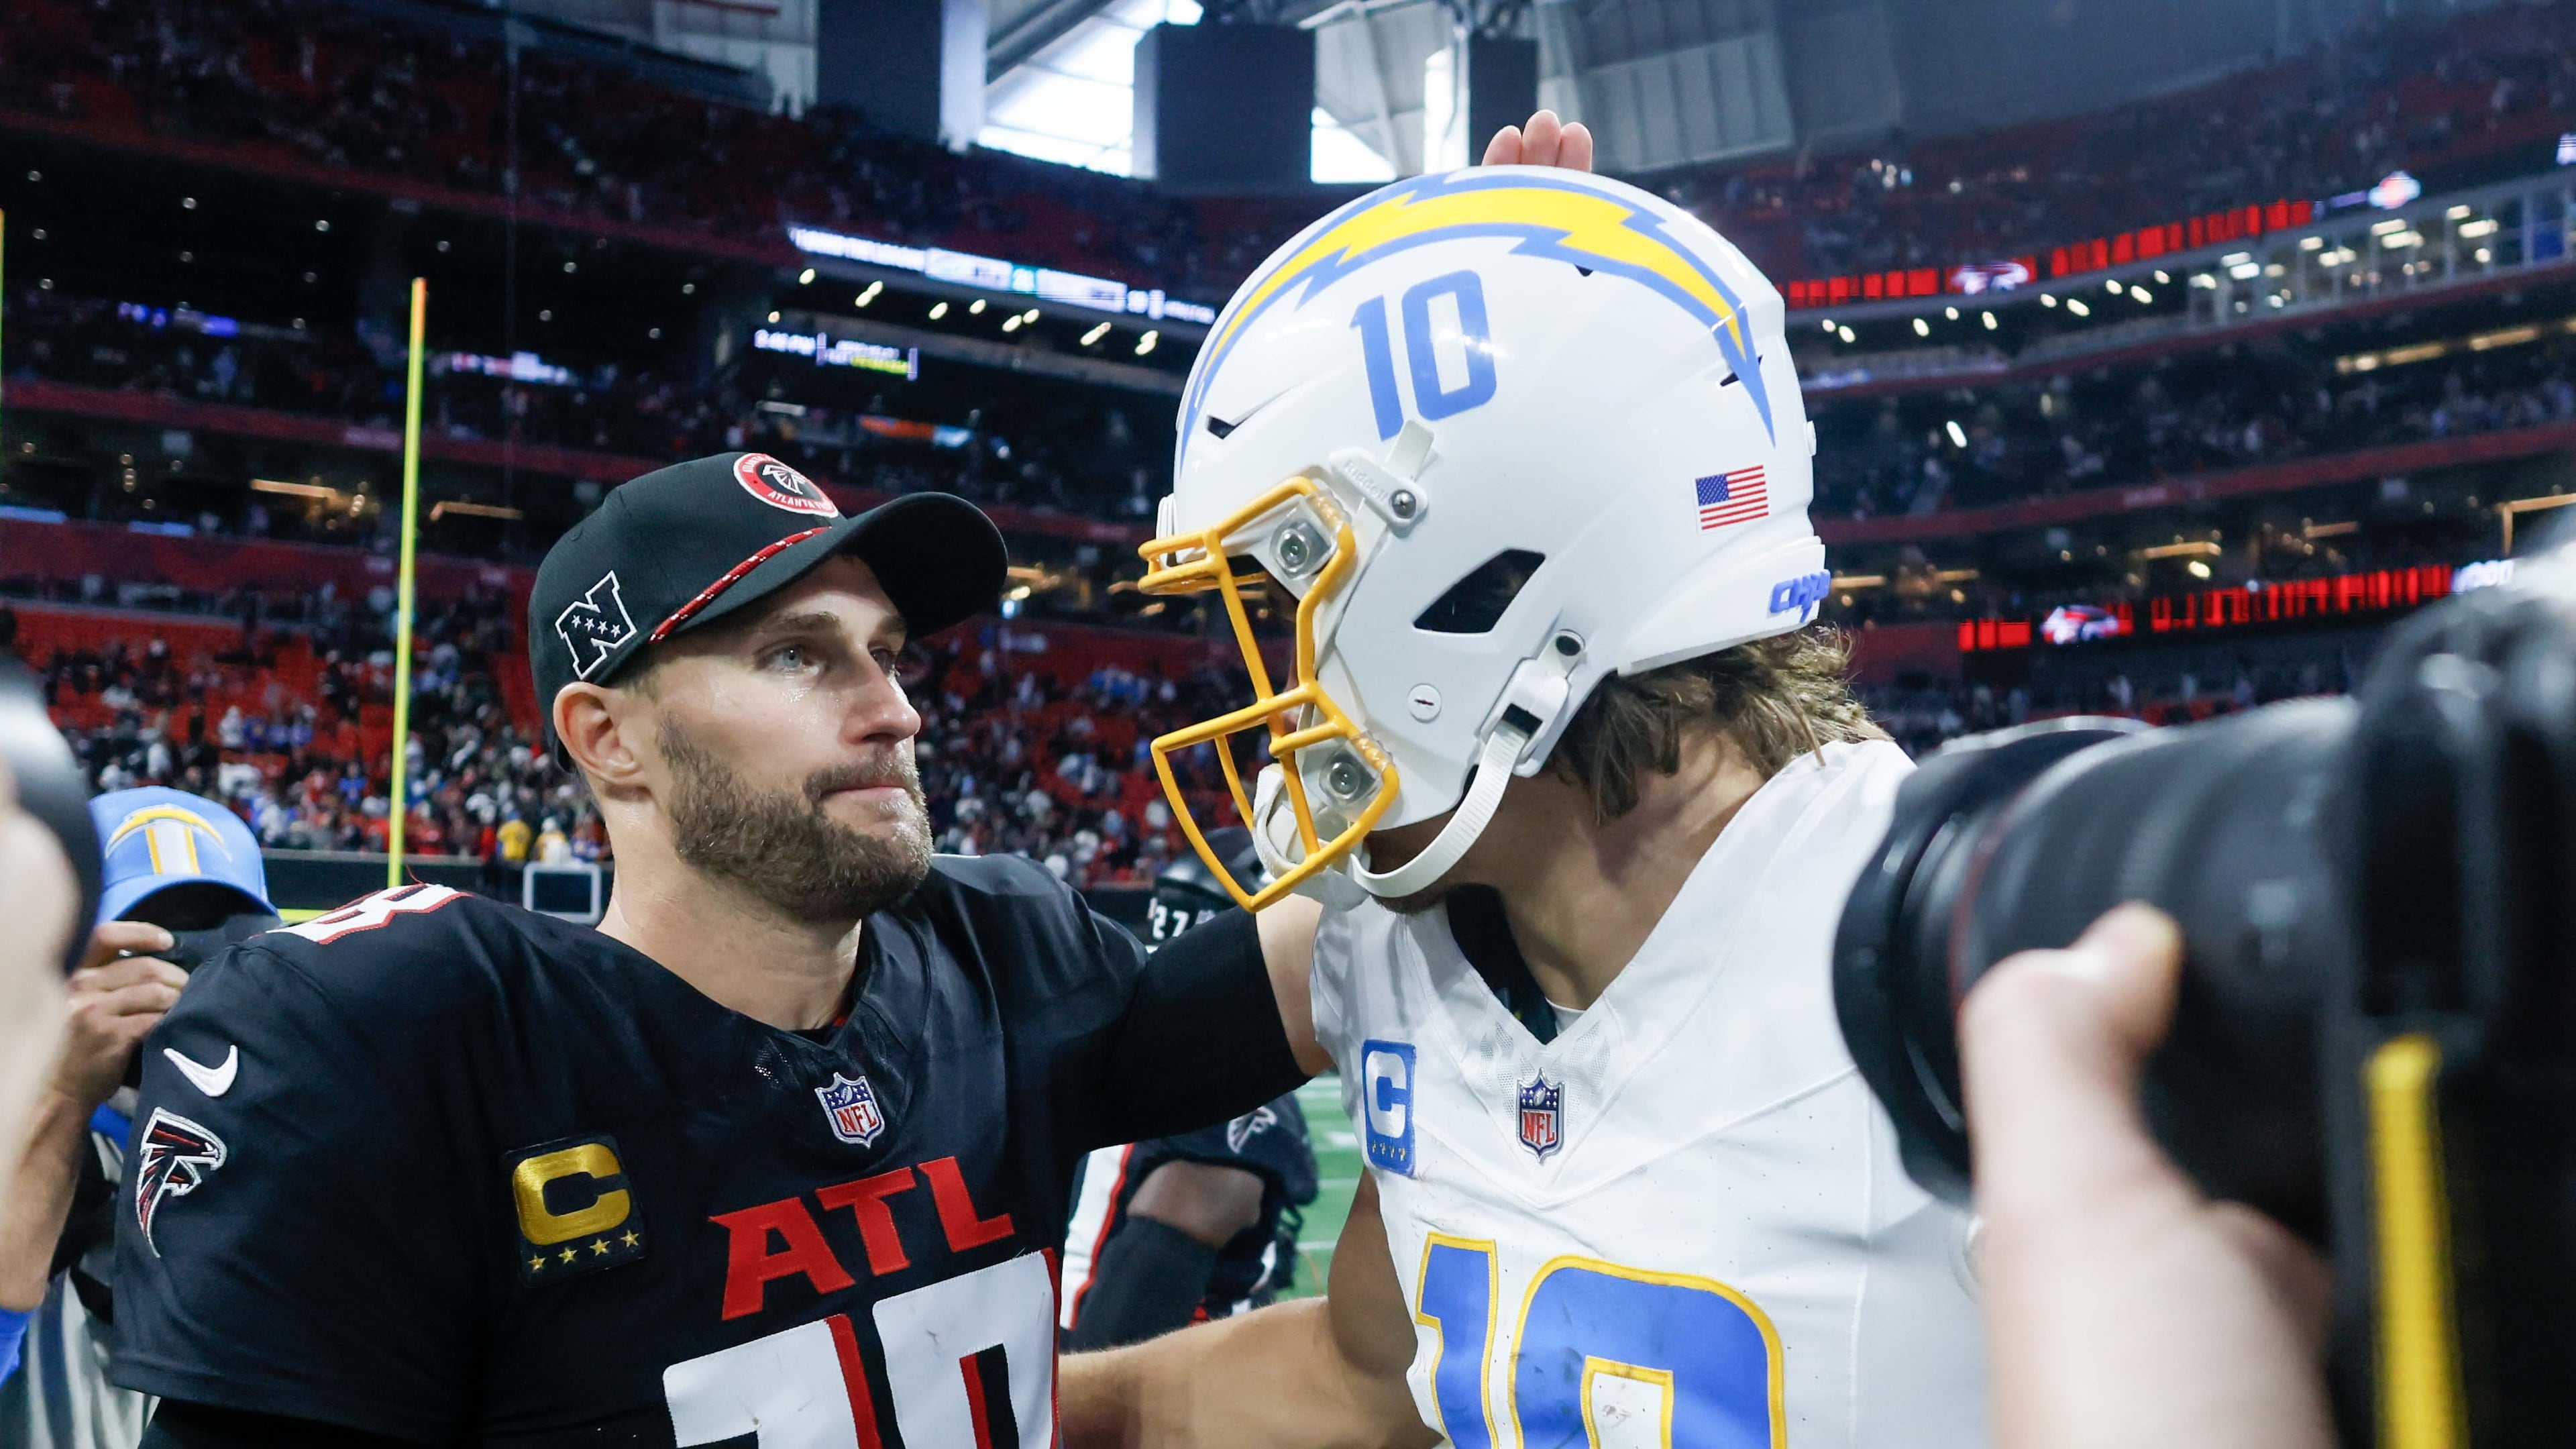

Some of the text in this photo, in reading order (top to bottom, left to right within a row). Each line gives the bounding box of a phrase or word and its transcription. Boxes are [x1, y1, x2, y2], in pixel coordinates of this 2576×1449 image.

[1348, 269, 1497, 441] 10
[767, 490, 815, 508] ATLANTA
[837, 1104, 877, 1133] NFL
[1365, 1051, 1407, 1138] C
[1523, 1112, 1556, 1146] NFL
[513, 1142, 632, 1245] C
[708, 1156, 1015, 1320] ATL
